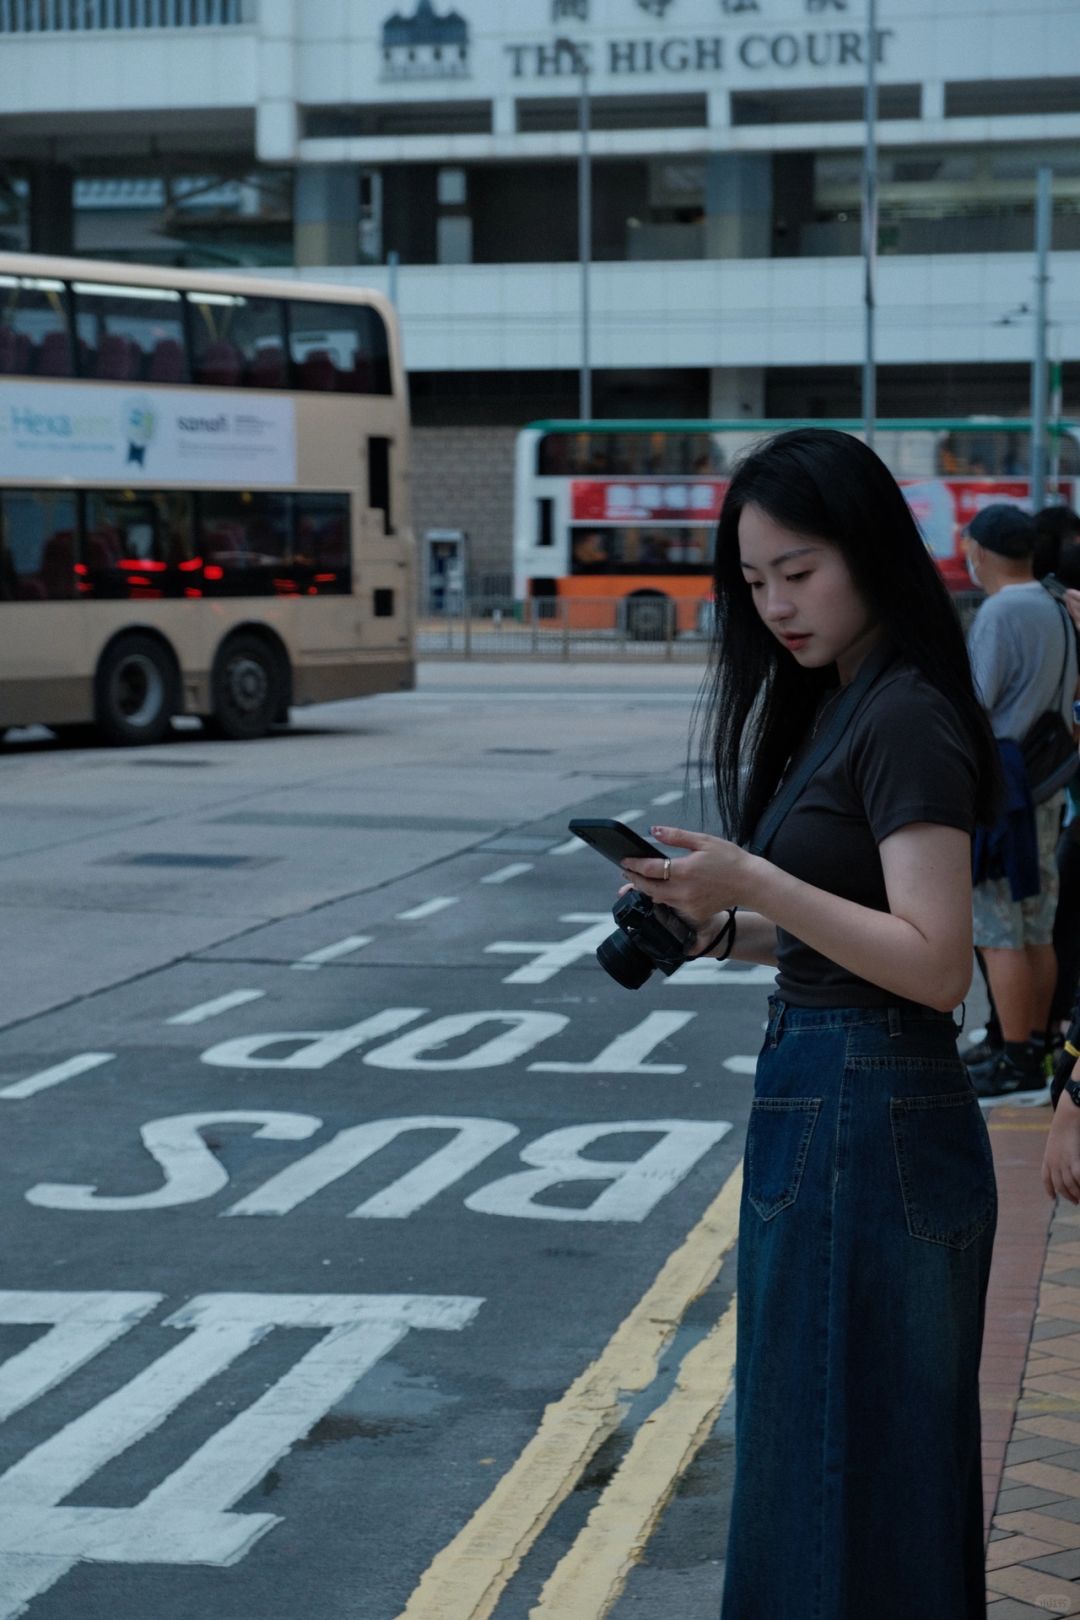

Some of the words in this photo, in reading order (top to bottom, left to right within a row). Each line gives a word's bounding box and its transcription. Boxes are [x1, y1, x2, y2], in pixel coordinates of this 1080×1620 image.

[503, 41, 593, 78] THE
[608, 38, 722, 74] HIGH
[739, 29, 895, 67] COURT
[200, 1008, 758, 1075] TOP
[25, 1110, 734, 1223] BUS
